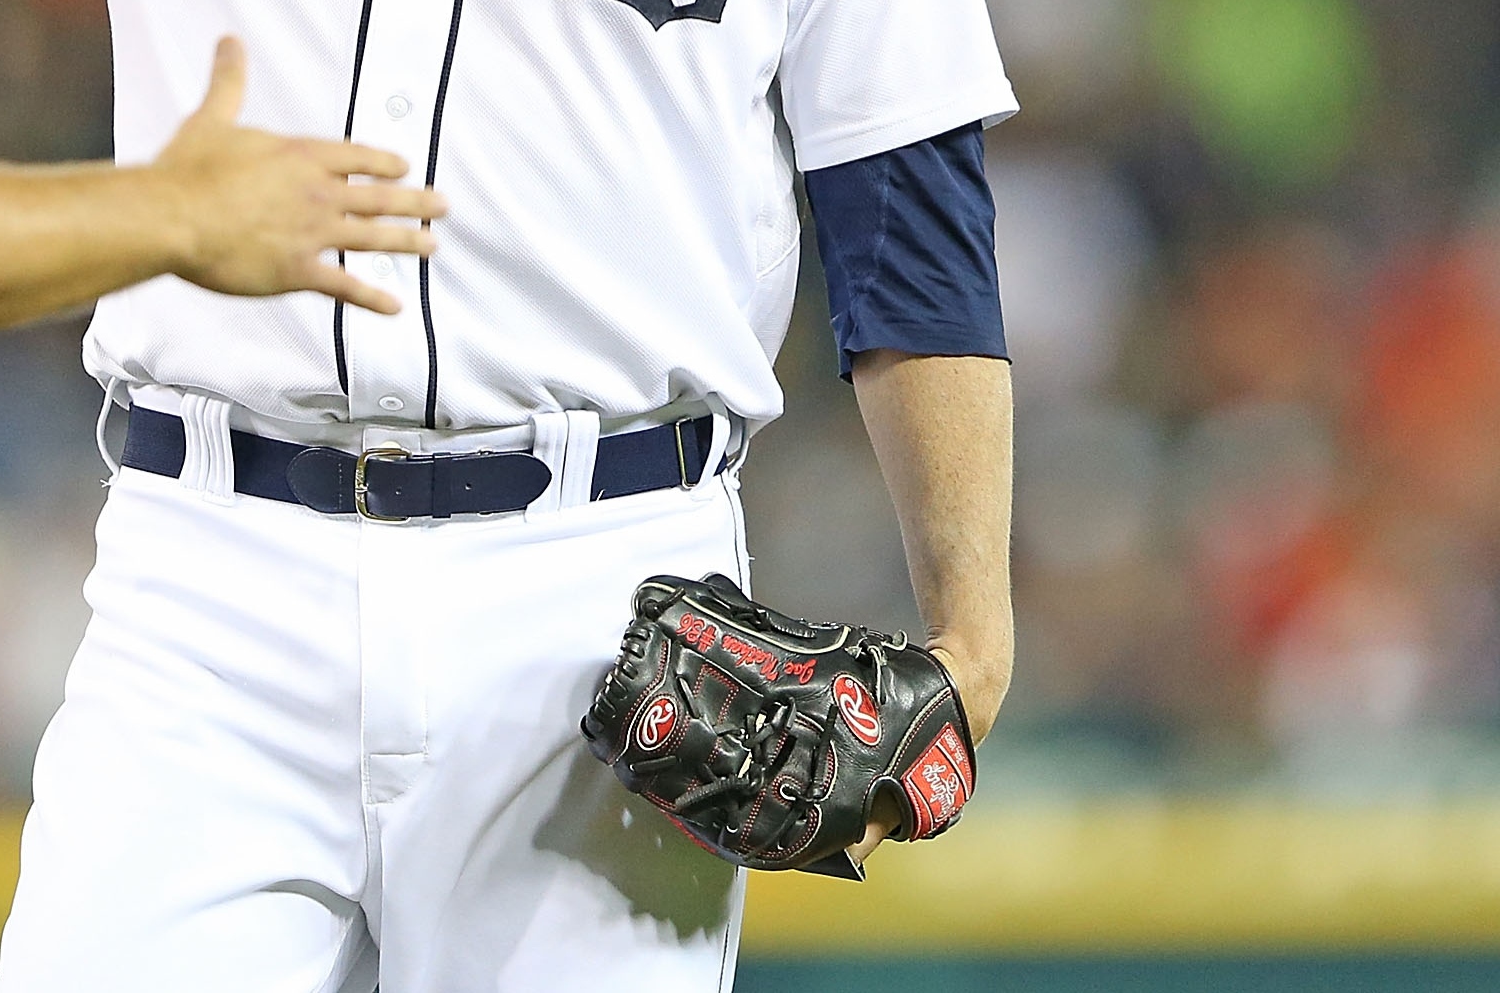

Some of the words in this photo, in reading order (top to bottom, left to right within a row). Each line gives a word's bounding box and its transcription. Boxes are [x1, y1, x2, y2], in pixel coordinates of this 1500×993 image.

[675, 612, 718, 653] #36
[721, 634, 780, 682] Nathan
[784, 658, 818, 685] Joe
[641, 703, 675, 746] R
[838, 680, 881, 739] R
